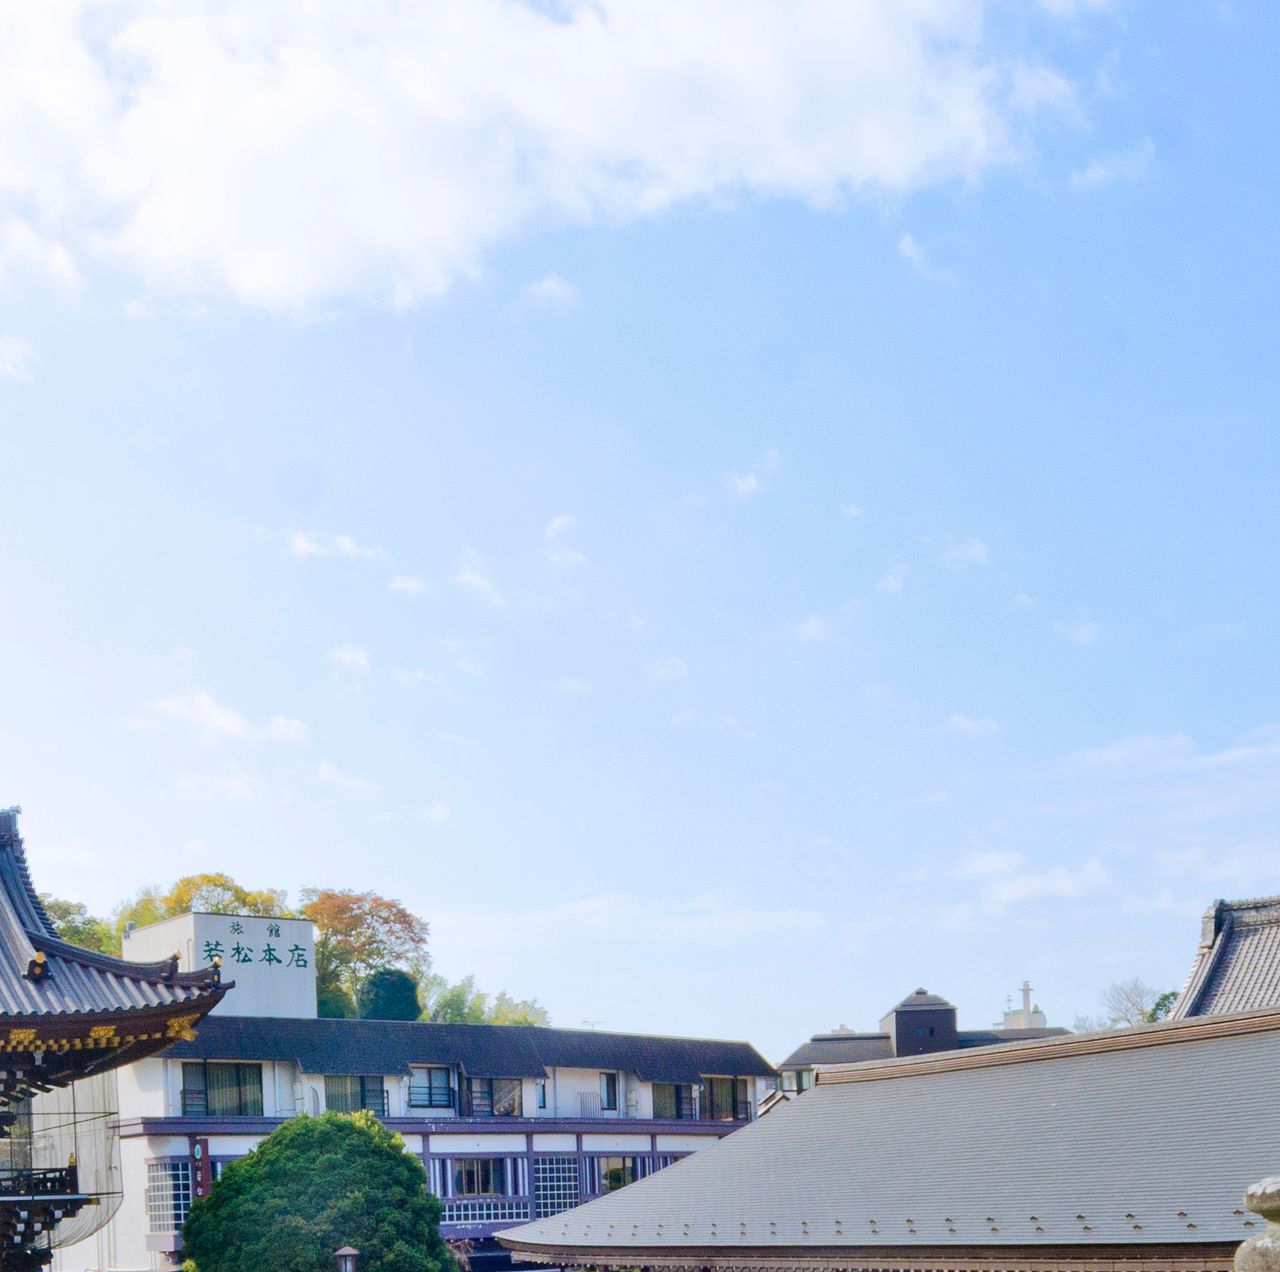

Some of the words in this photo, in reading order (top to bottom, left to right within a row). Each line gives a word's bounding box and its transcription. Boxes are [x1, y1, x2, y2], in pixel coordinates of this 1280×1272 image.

[229, 921, 281, 938] 旅館
[203, 940, 308, 968] 若松本店
